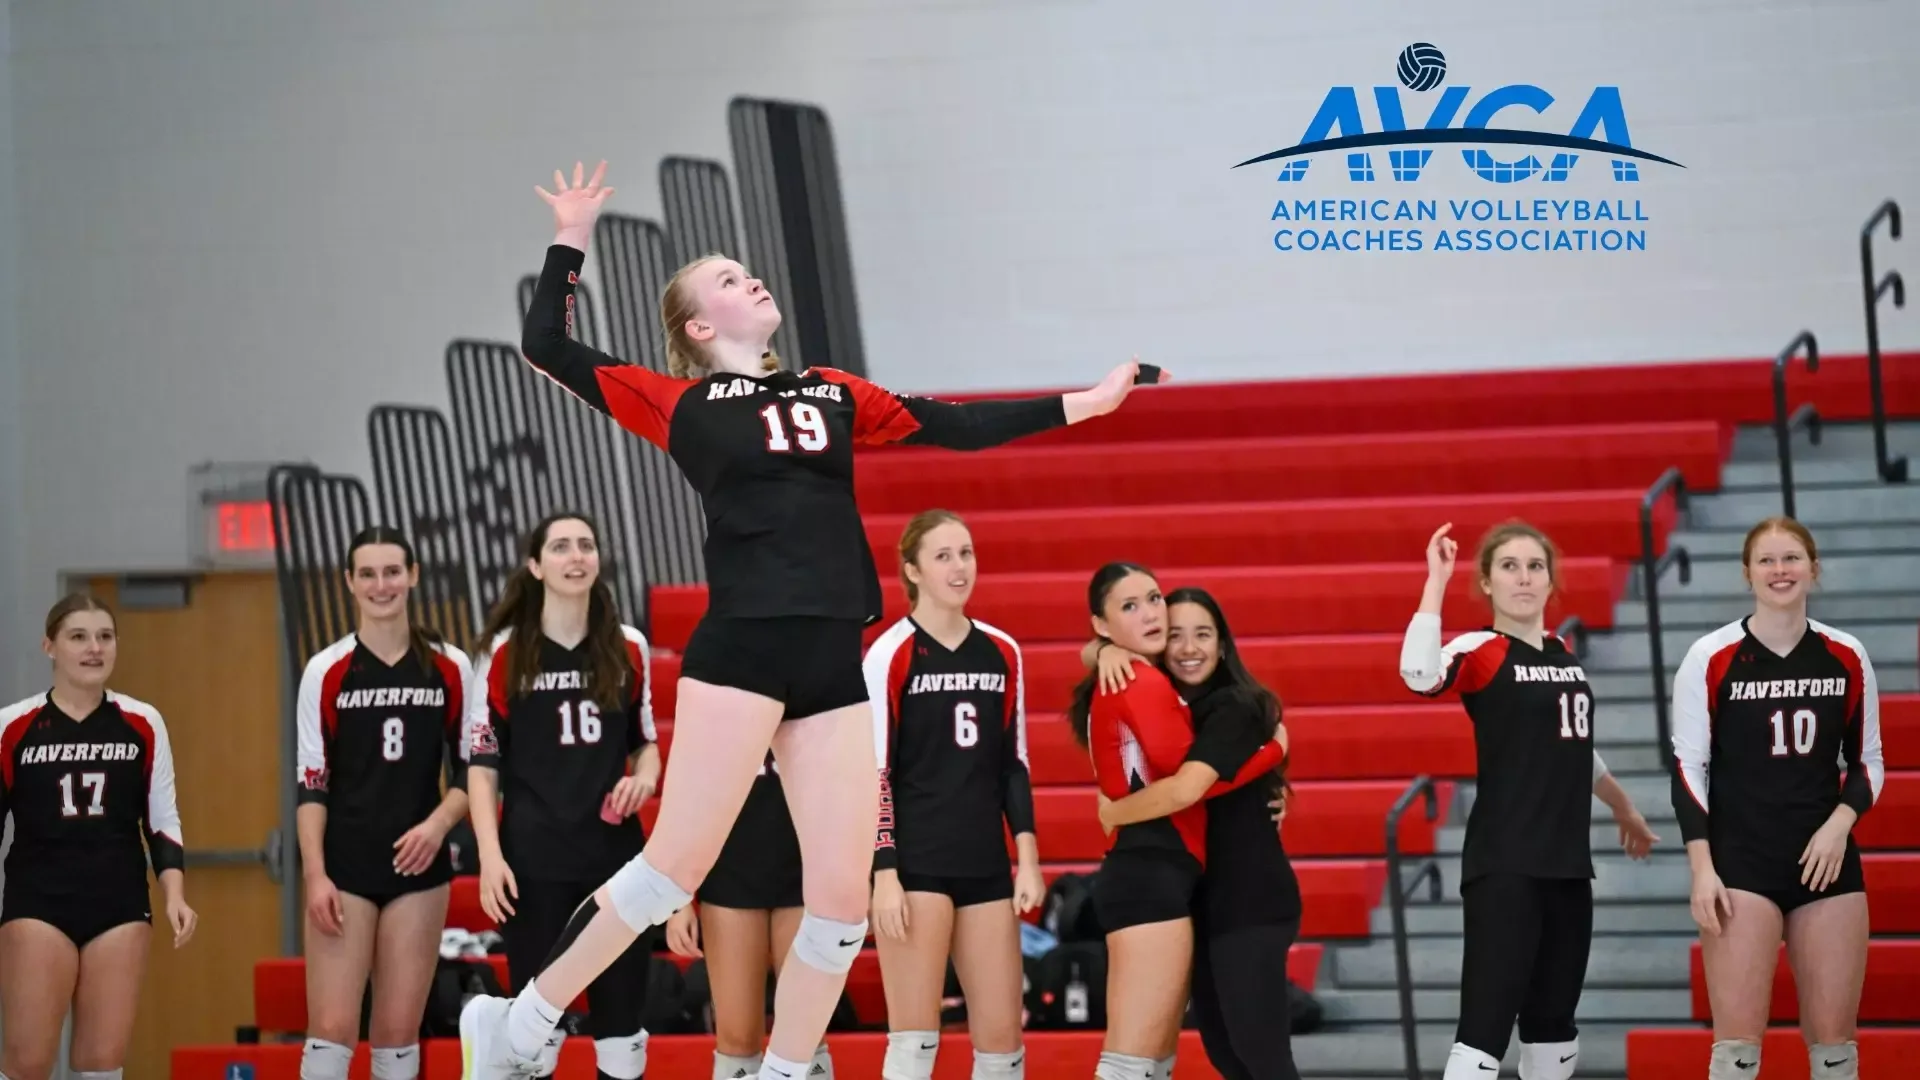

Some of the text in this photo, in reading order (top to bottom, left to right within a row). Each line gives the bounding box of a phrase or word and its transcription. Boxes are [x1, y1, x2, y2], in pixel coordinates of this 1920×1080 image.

[760, 402, 830, 453] 19
[336, 687, 445, 709] HAVERFORD
[1729, 677, 1846, 701] HAVERFORD
[558, 700, 602, 745] 16
[954, 702, 978, 748] 6
[1558, 692, 1590, 738] 18
[1770, 708, 1817, 756] 10
[20, 742, 139, 765] HAVERFORD
[382, 717, 404, 761] 8
[59, 771, 106, 817] 17
